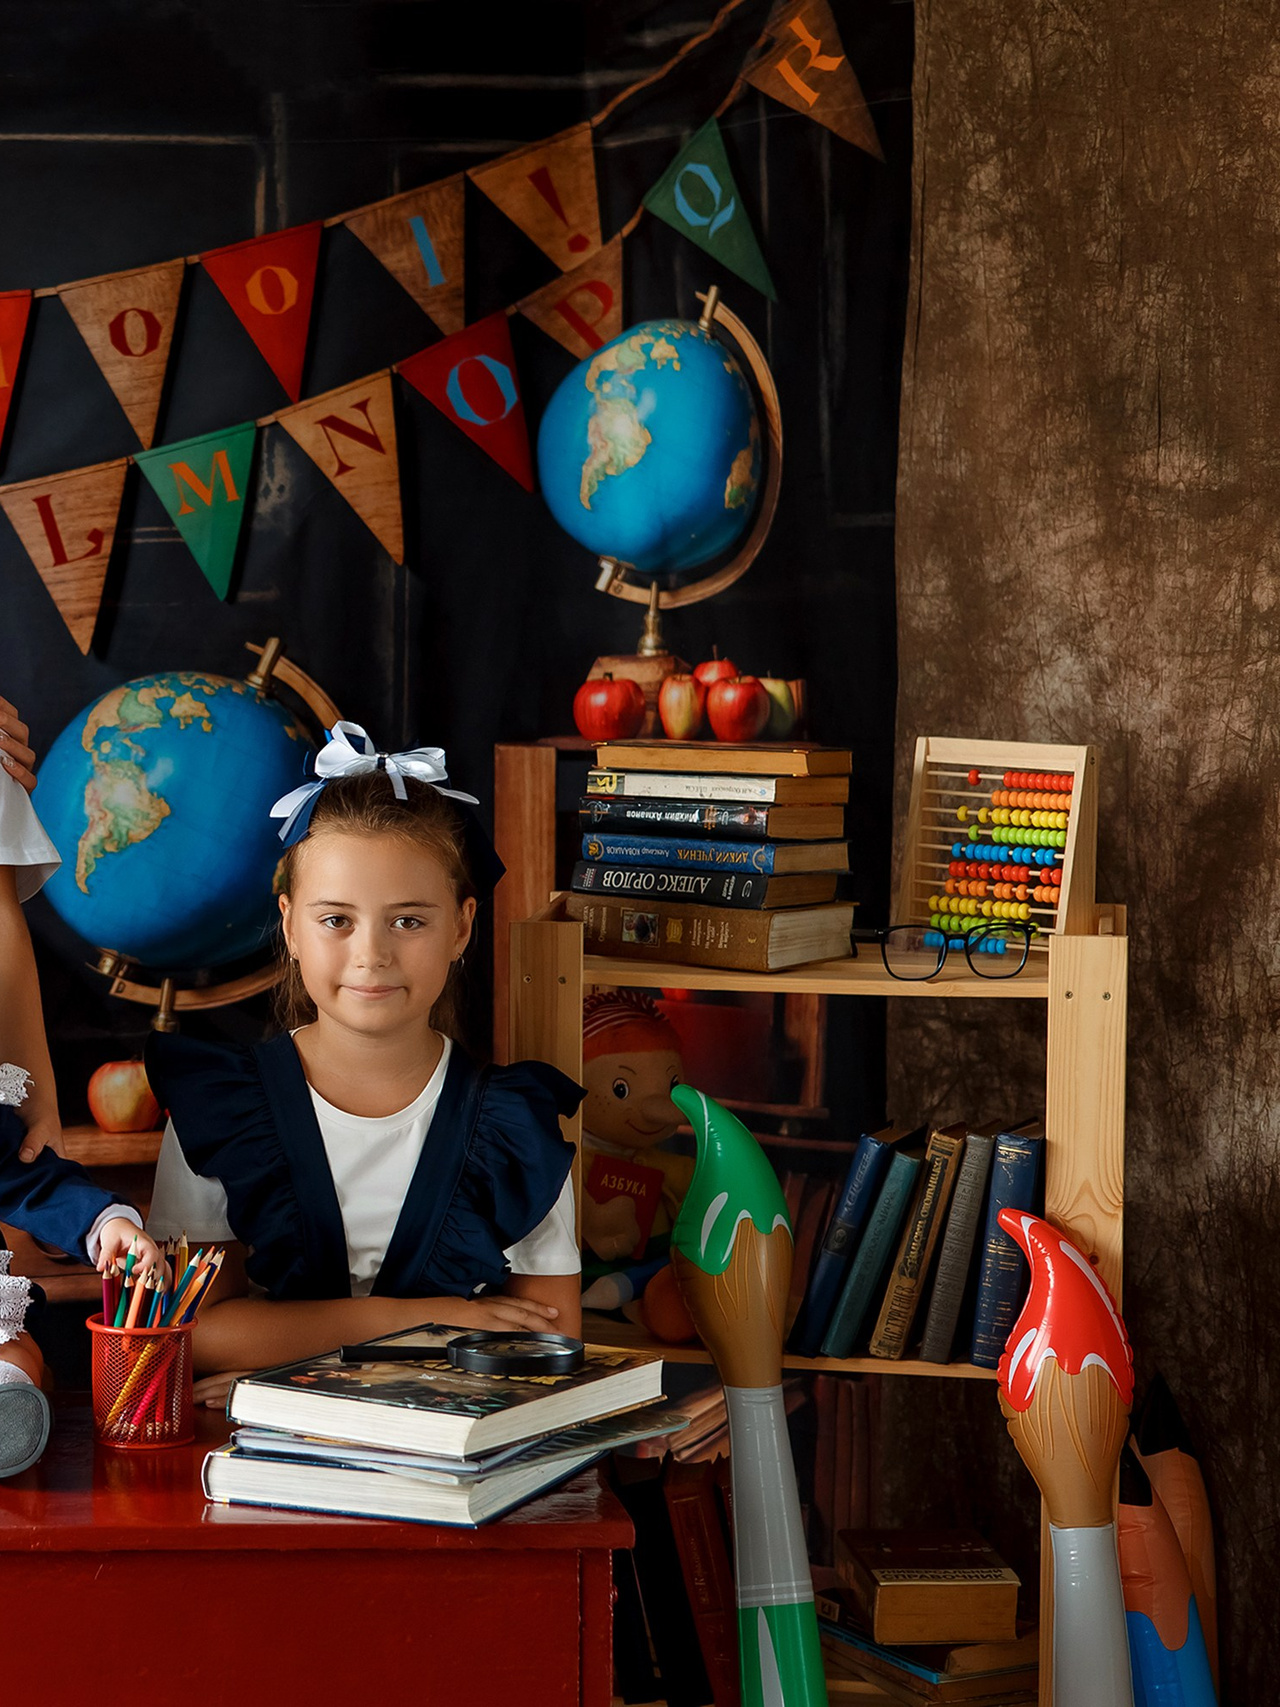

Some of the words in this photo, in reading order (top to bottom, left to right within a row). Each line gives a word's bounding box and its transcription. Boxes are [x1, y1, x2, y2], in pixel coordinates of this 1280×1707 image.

[677, 849, 716, 862] УЧЕНИК
[602, 870, 655, 890] ОРЛОВ
[657, 874, 712, 894] АЛЕКС
[600, 1173, 647, 1196] АЗБУКА
